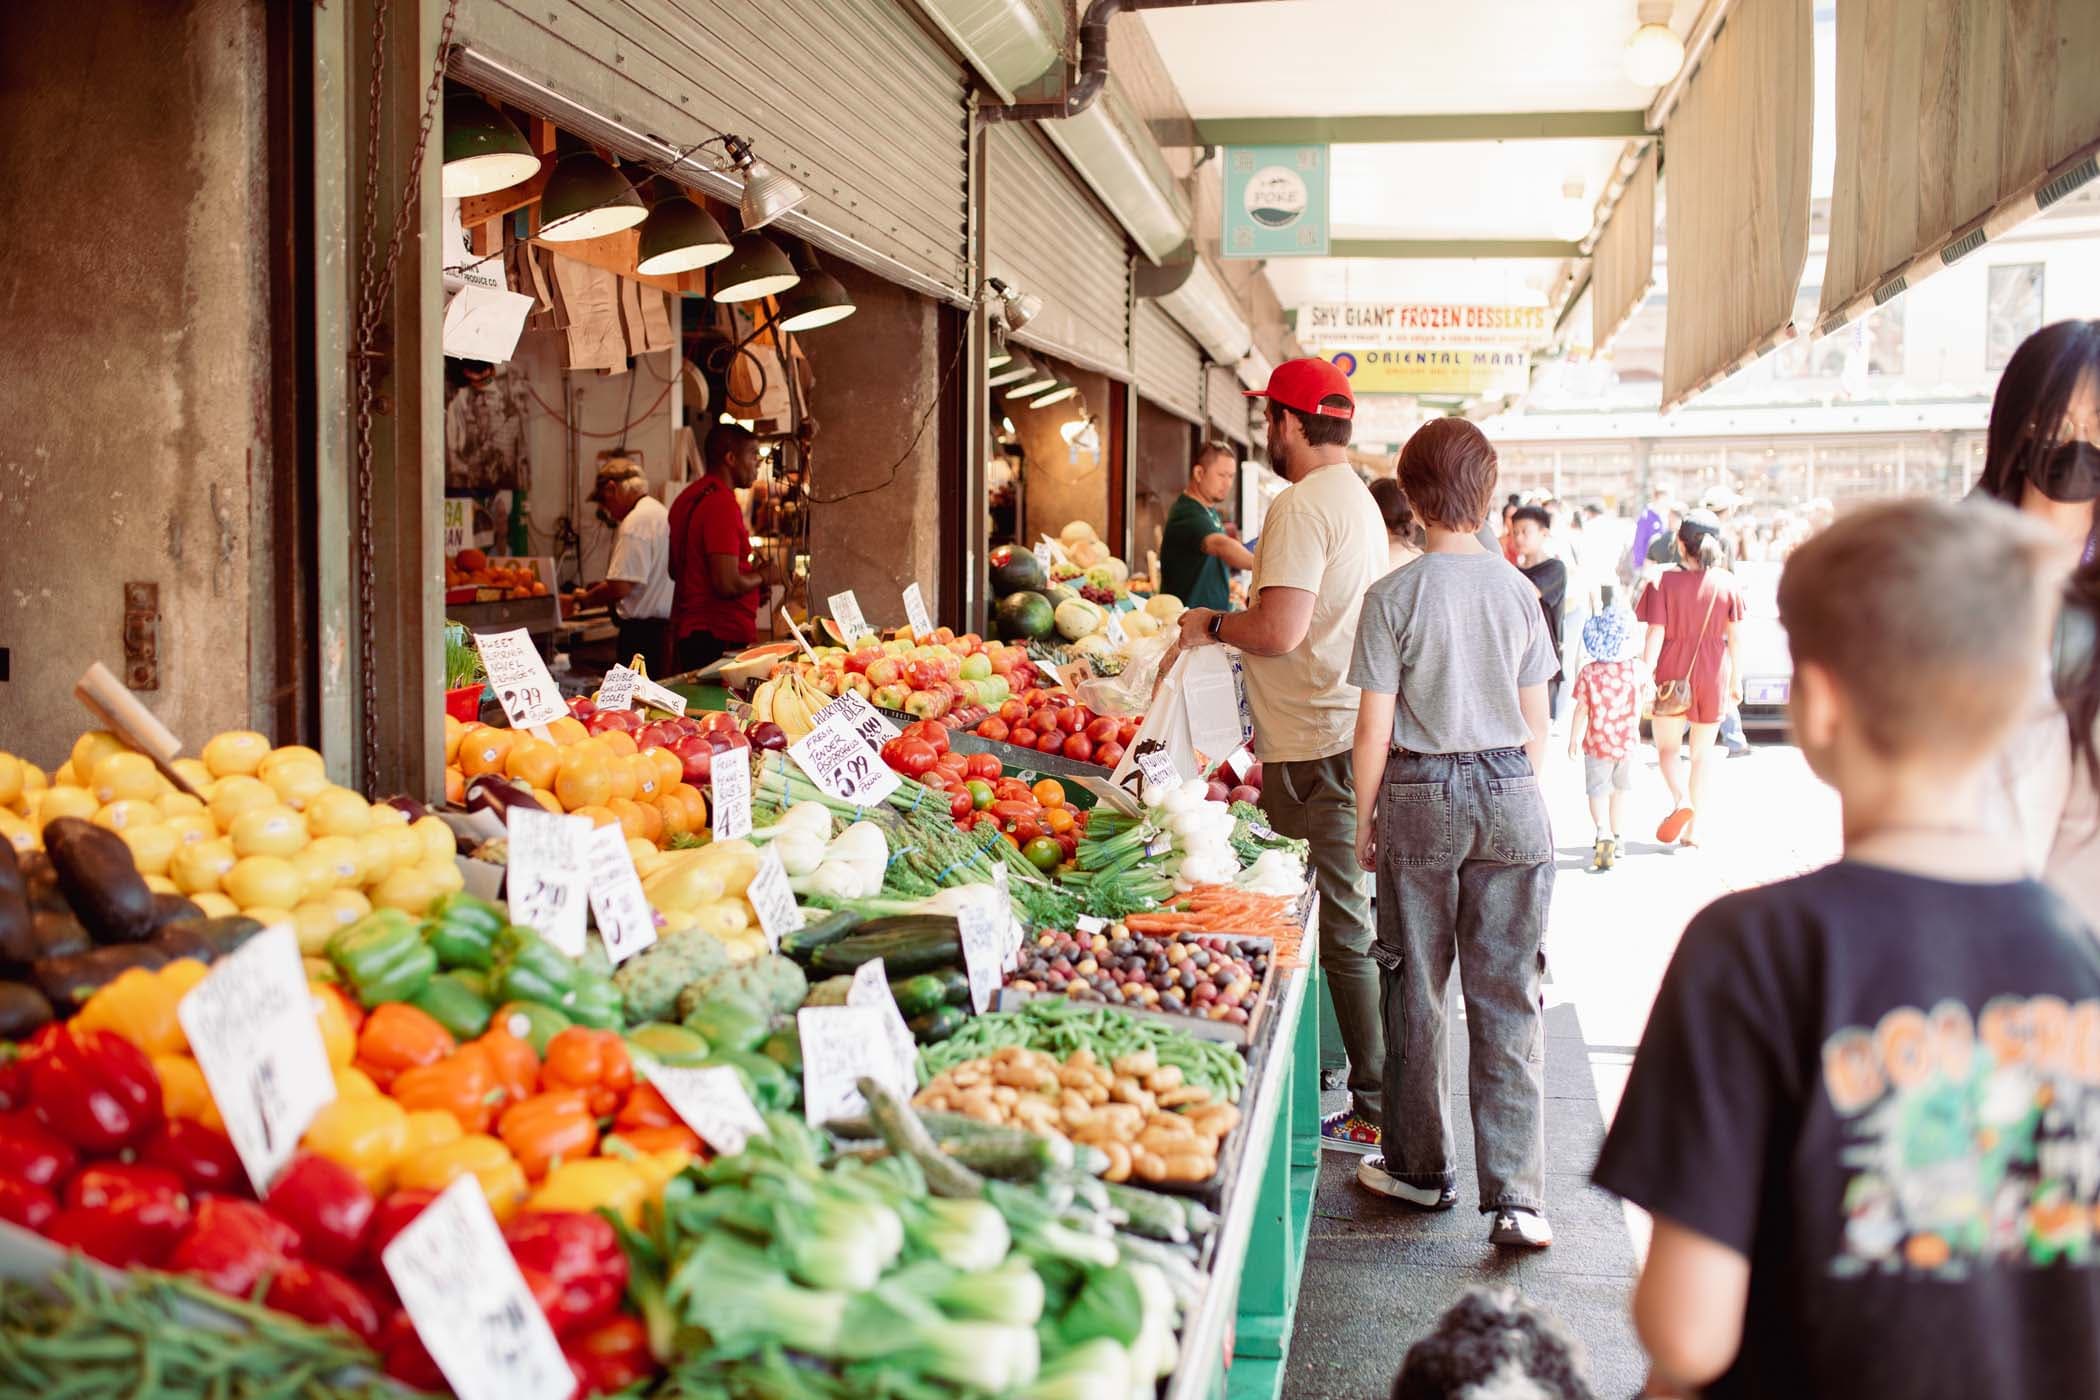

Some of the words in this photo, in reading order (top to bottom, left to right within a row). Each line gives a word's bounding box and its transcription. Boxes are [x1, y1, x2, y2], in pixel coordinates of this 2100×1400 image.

[1346, 306, 1394, 328] GIANT
[1400, 306, 1460, 328] FROZEN
[1466, 306, 1544, 328] DESSERTS
[1366, 351, 1461, 365] ORIENTAL
[1473, 352, 1524, 365] MART
[806, 725, 833, 748] FRESH
[809, 734, 847, 763] TENDER
[816, 739, 860, 775] ASPARAGUS
[859, 772, 883, 793] POUND
